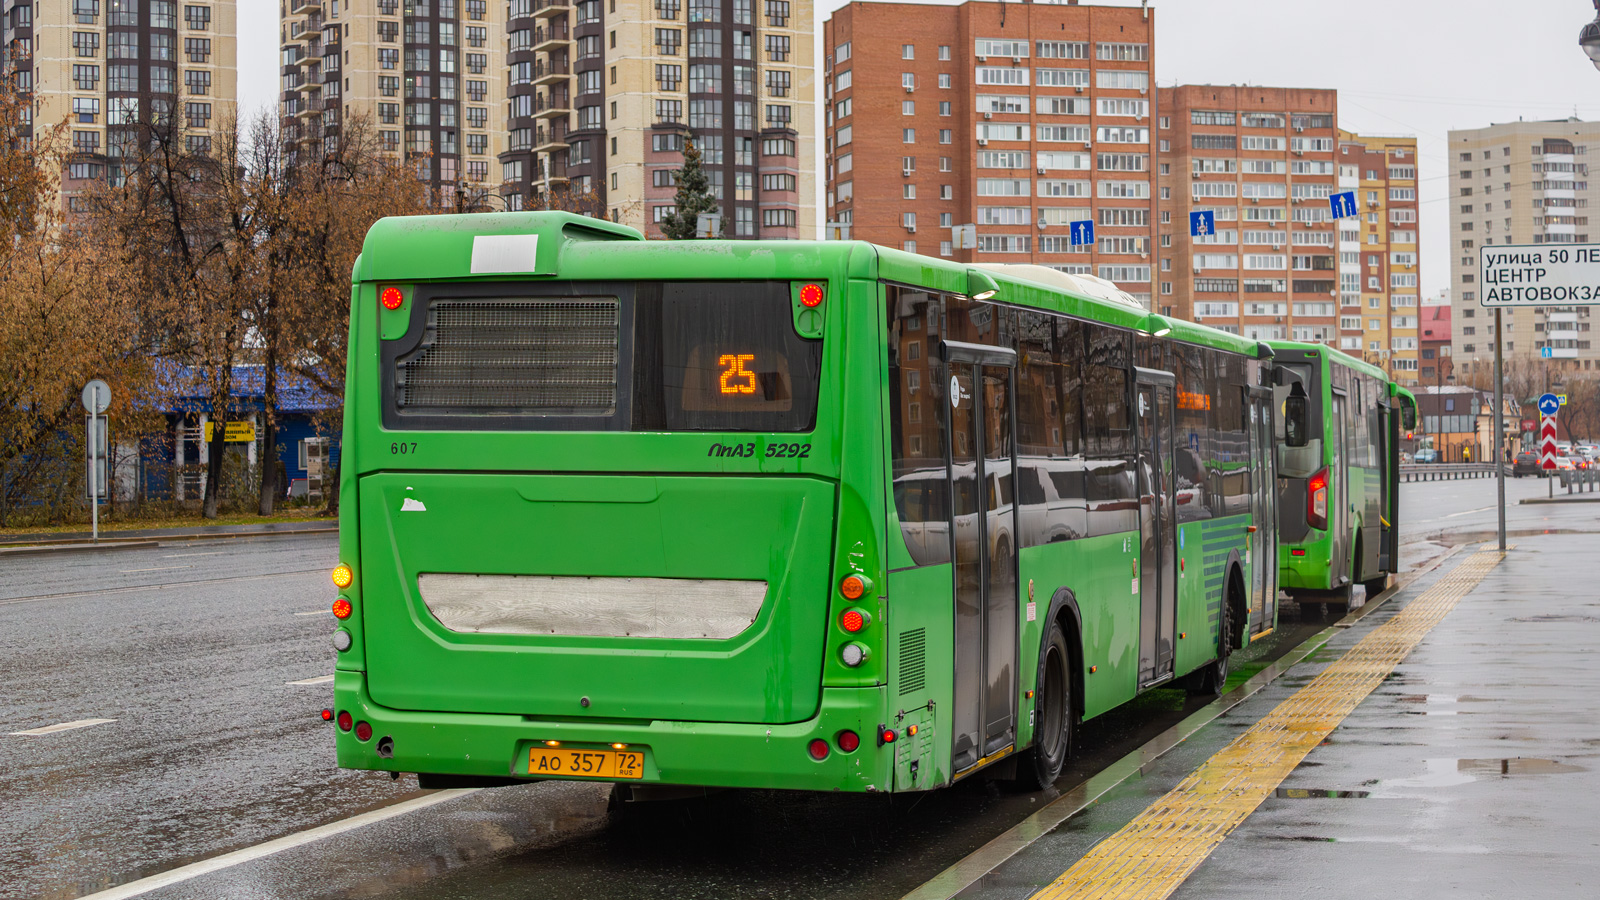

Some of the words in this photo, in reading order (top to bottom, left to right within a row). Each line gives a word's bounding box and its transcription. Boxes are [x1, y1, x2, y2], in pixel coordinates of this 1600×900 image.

[1486, 252, 1542, 268] улица
[1549, 249, 1569, 263] 50
[1486, 268, 1546, 286] ЦЕНТР
[719, 354, 756, 393] 25
[391, 442, 417, 455] 607
[764, 443, 812, 458] 5292
[570, 753, 606, 773] 357
[618, 754, 637, 769] 72
[619, 768, 633, 776] RUS
